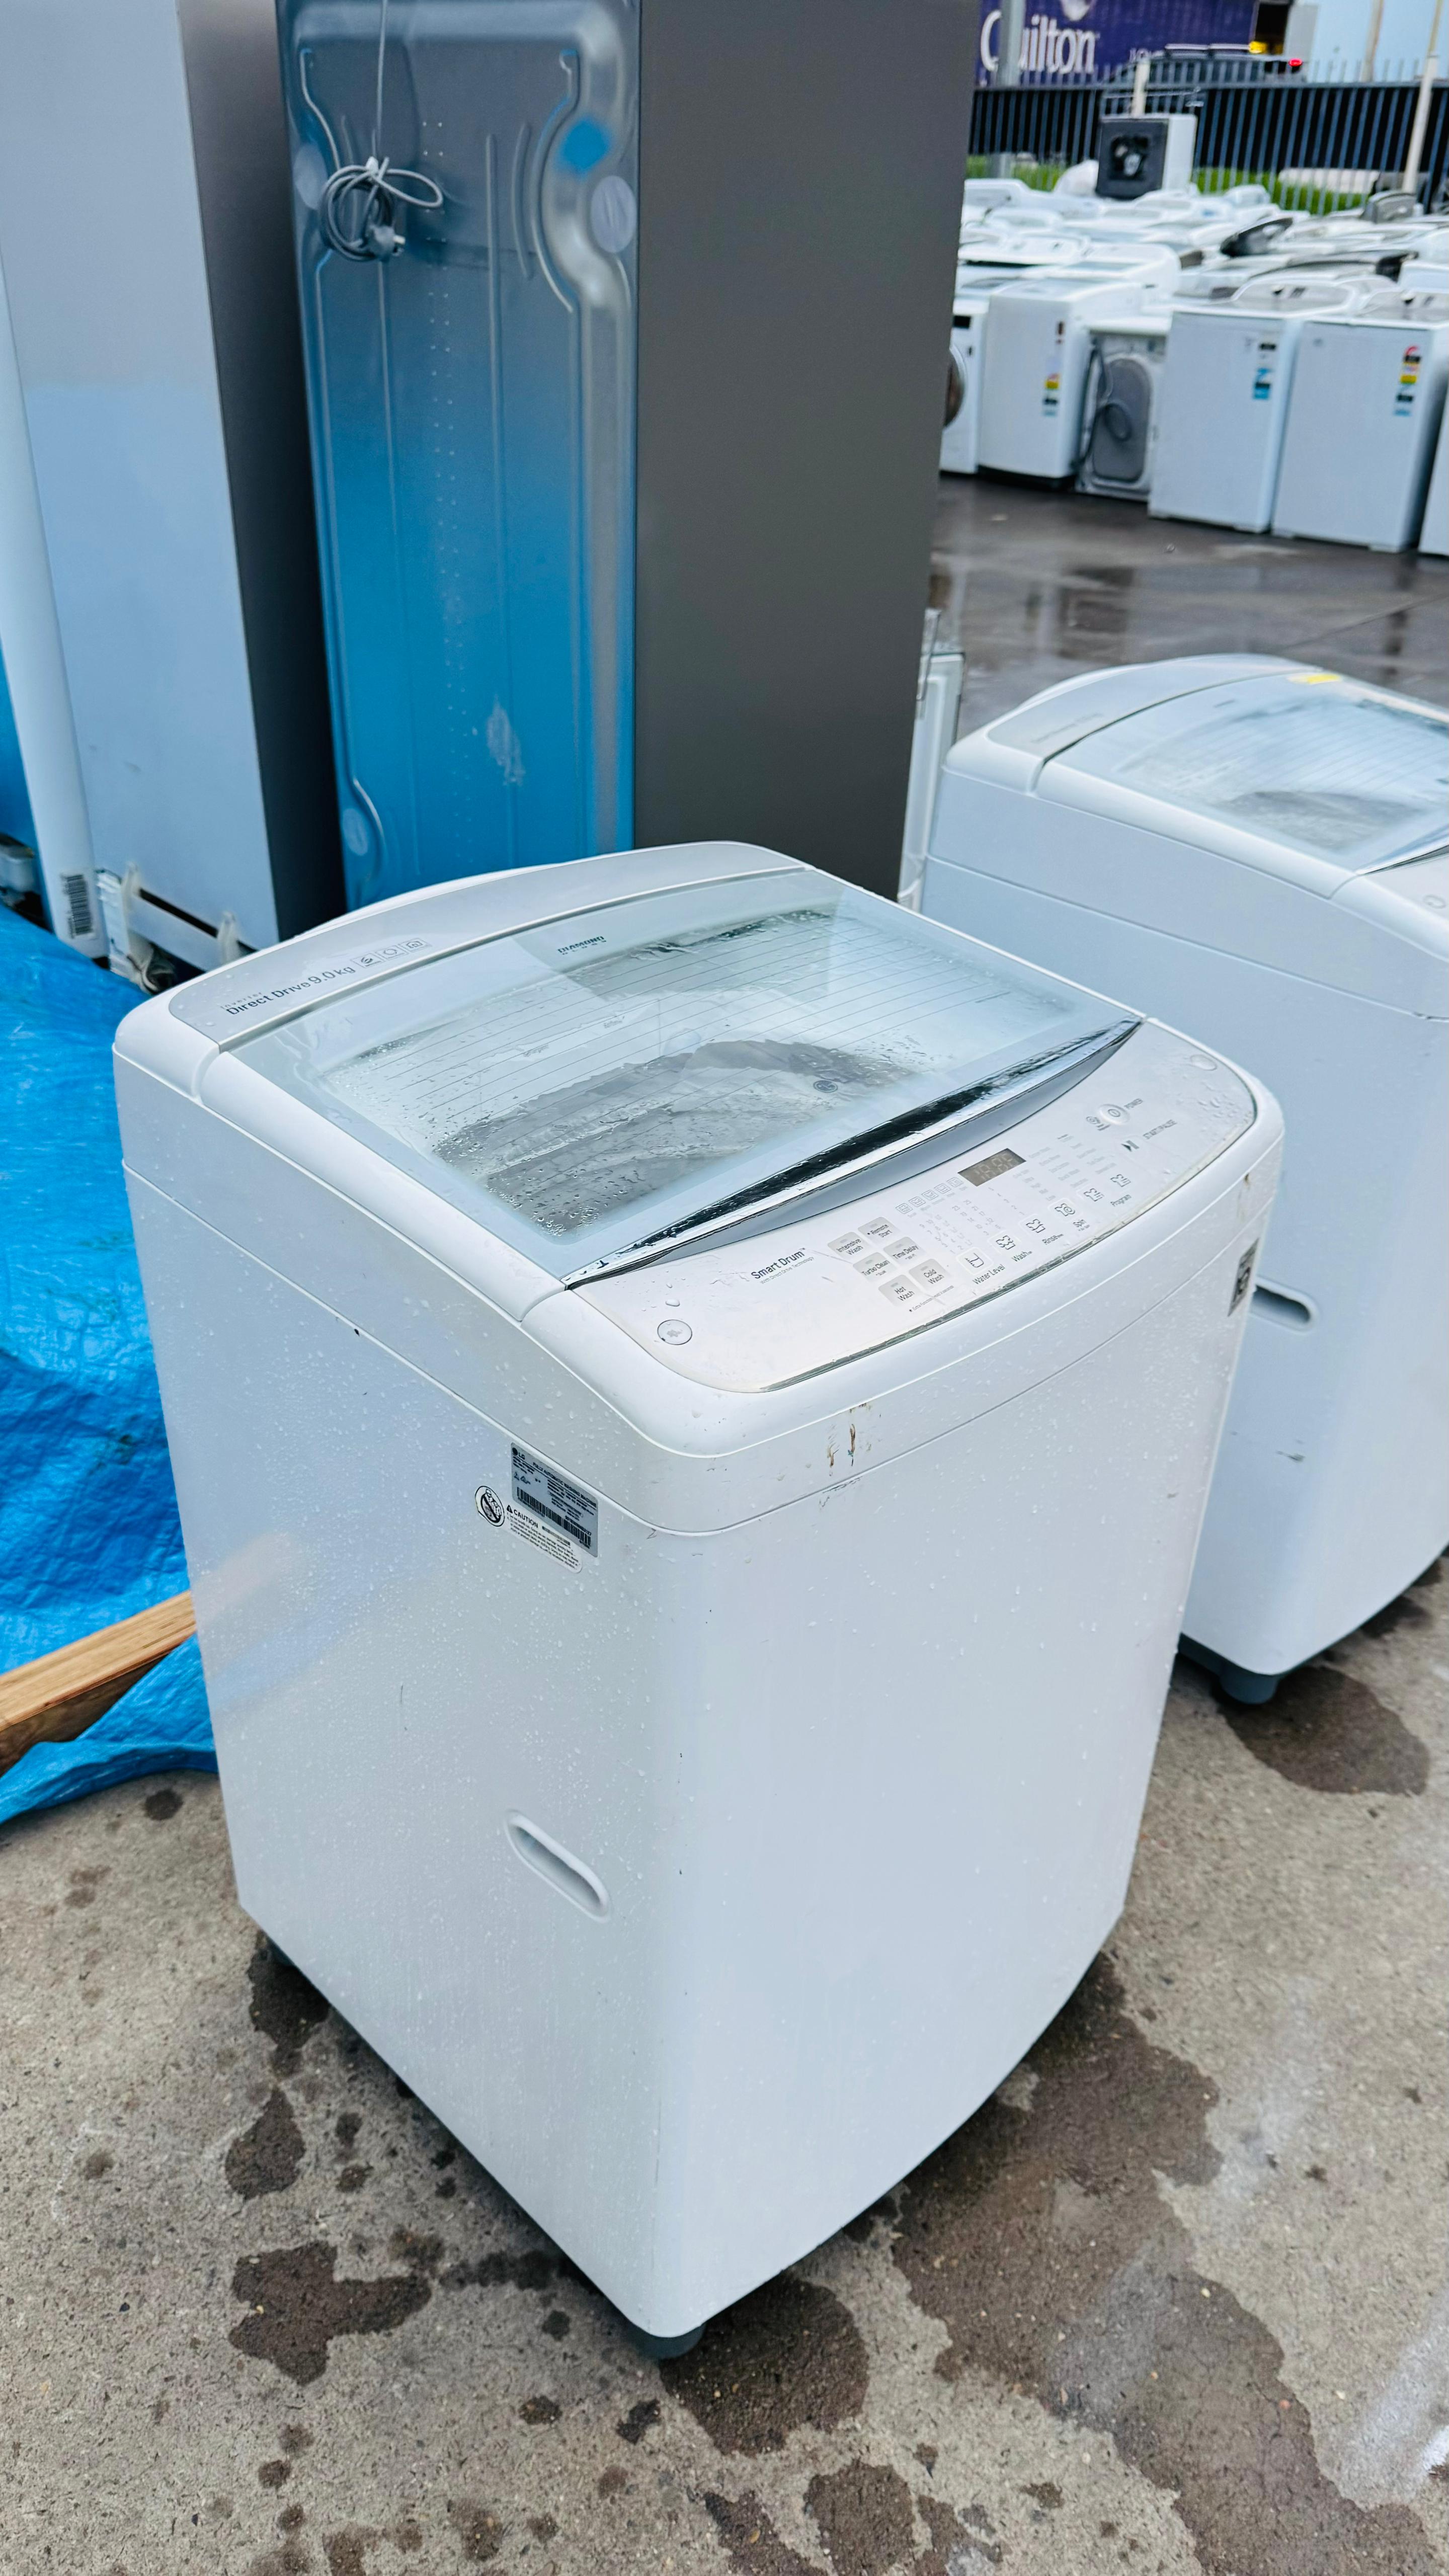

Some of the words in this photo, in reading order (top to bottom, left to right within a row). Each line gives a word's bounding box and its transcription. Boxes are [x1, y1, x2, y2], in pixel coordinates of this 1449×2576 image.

[557, 936, 604, 953] DIAMOND
[226, 996, 273, 1014] Direct
[271, 982, 310, 997] Drive
[1042, 1235, 1058, 1245] Rinse
[836, 1238, 862, 1253] Intensive
[846, 1245, 863, 1255] Wash
[1011, 1252, 1027, 1262] Wash
[751, 1261, 780, 1279] Smart
[861, 1267, 877, 1276] Turbo
[972, 1272, 991, 1284] Water
[989, 1264, 1005, 1275] Level
[928, 1274, 945, 1284] Wash
[894, 1286, 907, 1294] Hot
[898, 1291, 915, 1301] Wash
[513, 1509, 538, 1528] CAUTION
